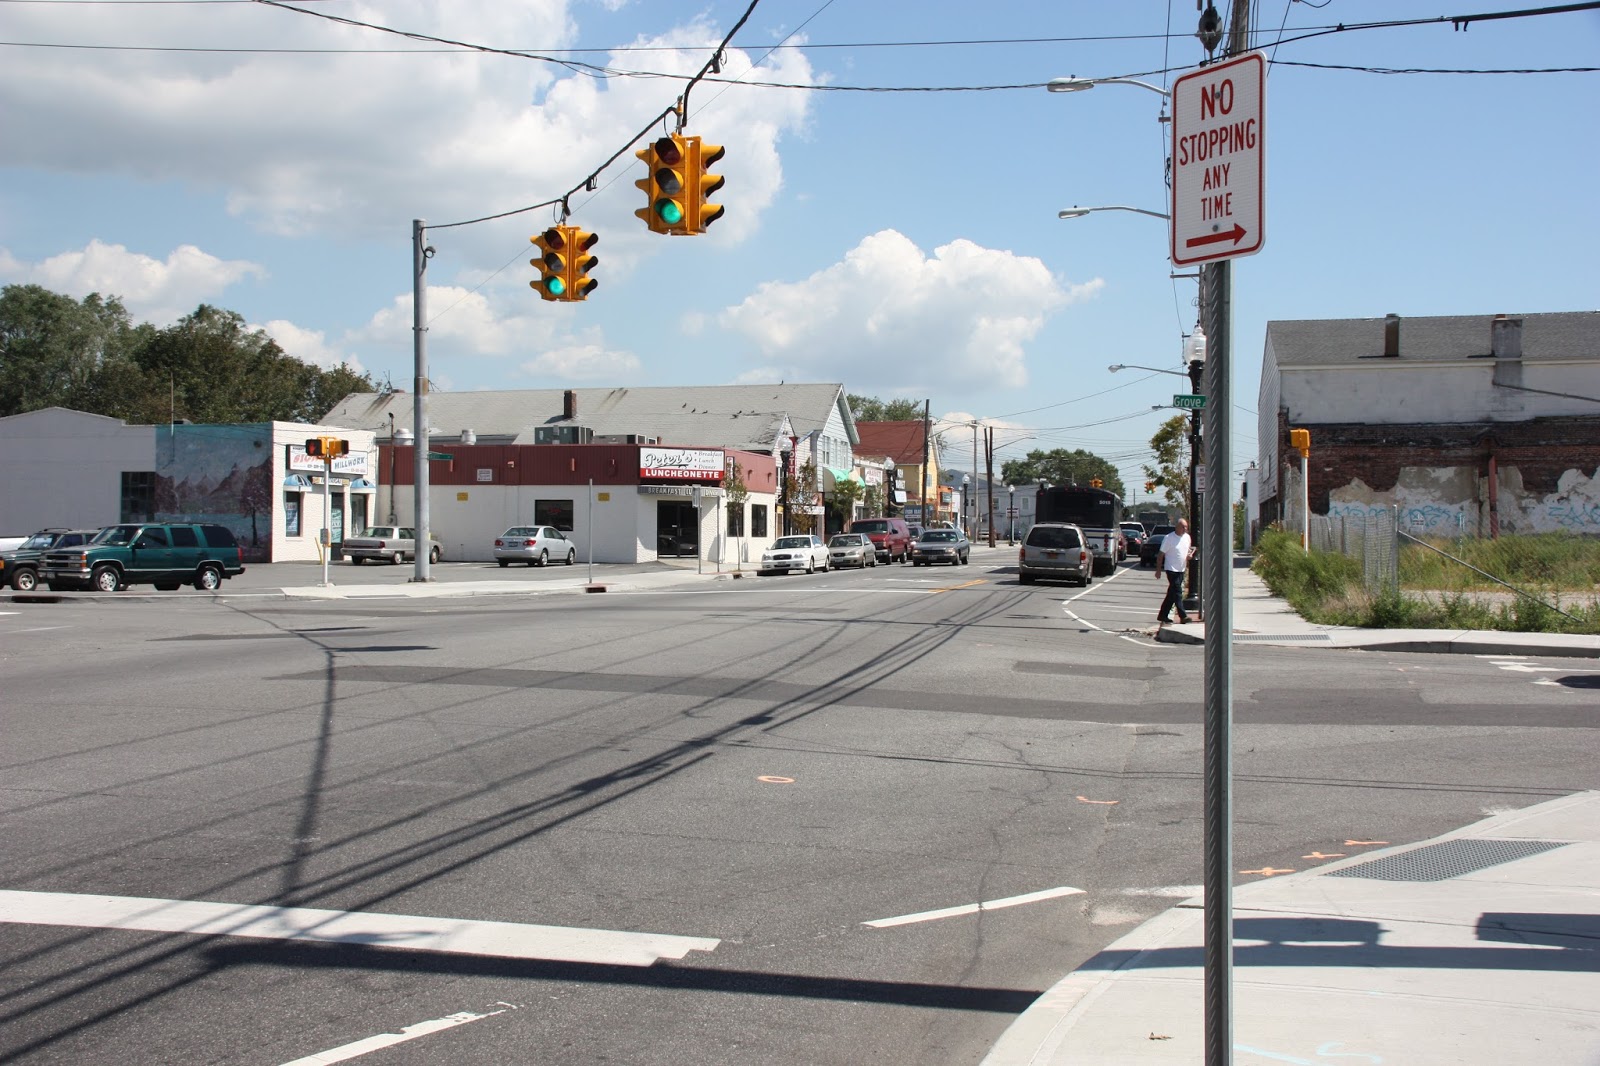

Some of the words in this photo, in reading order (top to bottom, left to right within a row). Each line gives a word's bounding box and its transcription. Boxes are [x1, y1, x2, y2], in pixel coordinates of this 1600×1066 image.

[1201, 78, 1234, 120] NO
[1180, 118, 1256, 166] STOPPING
[1203, 162, 1231, 191] ANY
[1201, 192, 1233, 221] TIME
[1174, 396, 1201, 407] Grove
[334, 457, 365, 470] MILLWORK
[645, 469, 719, 479] LUNCHEONETTE
[648, 487, 681, 495] BREAKFAST
